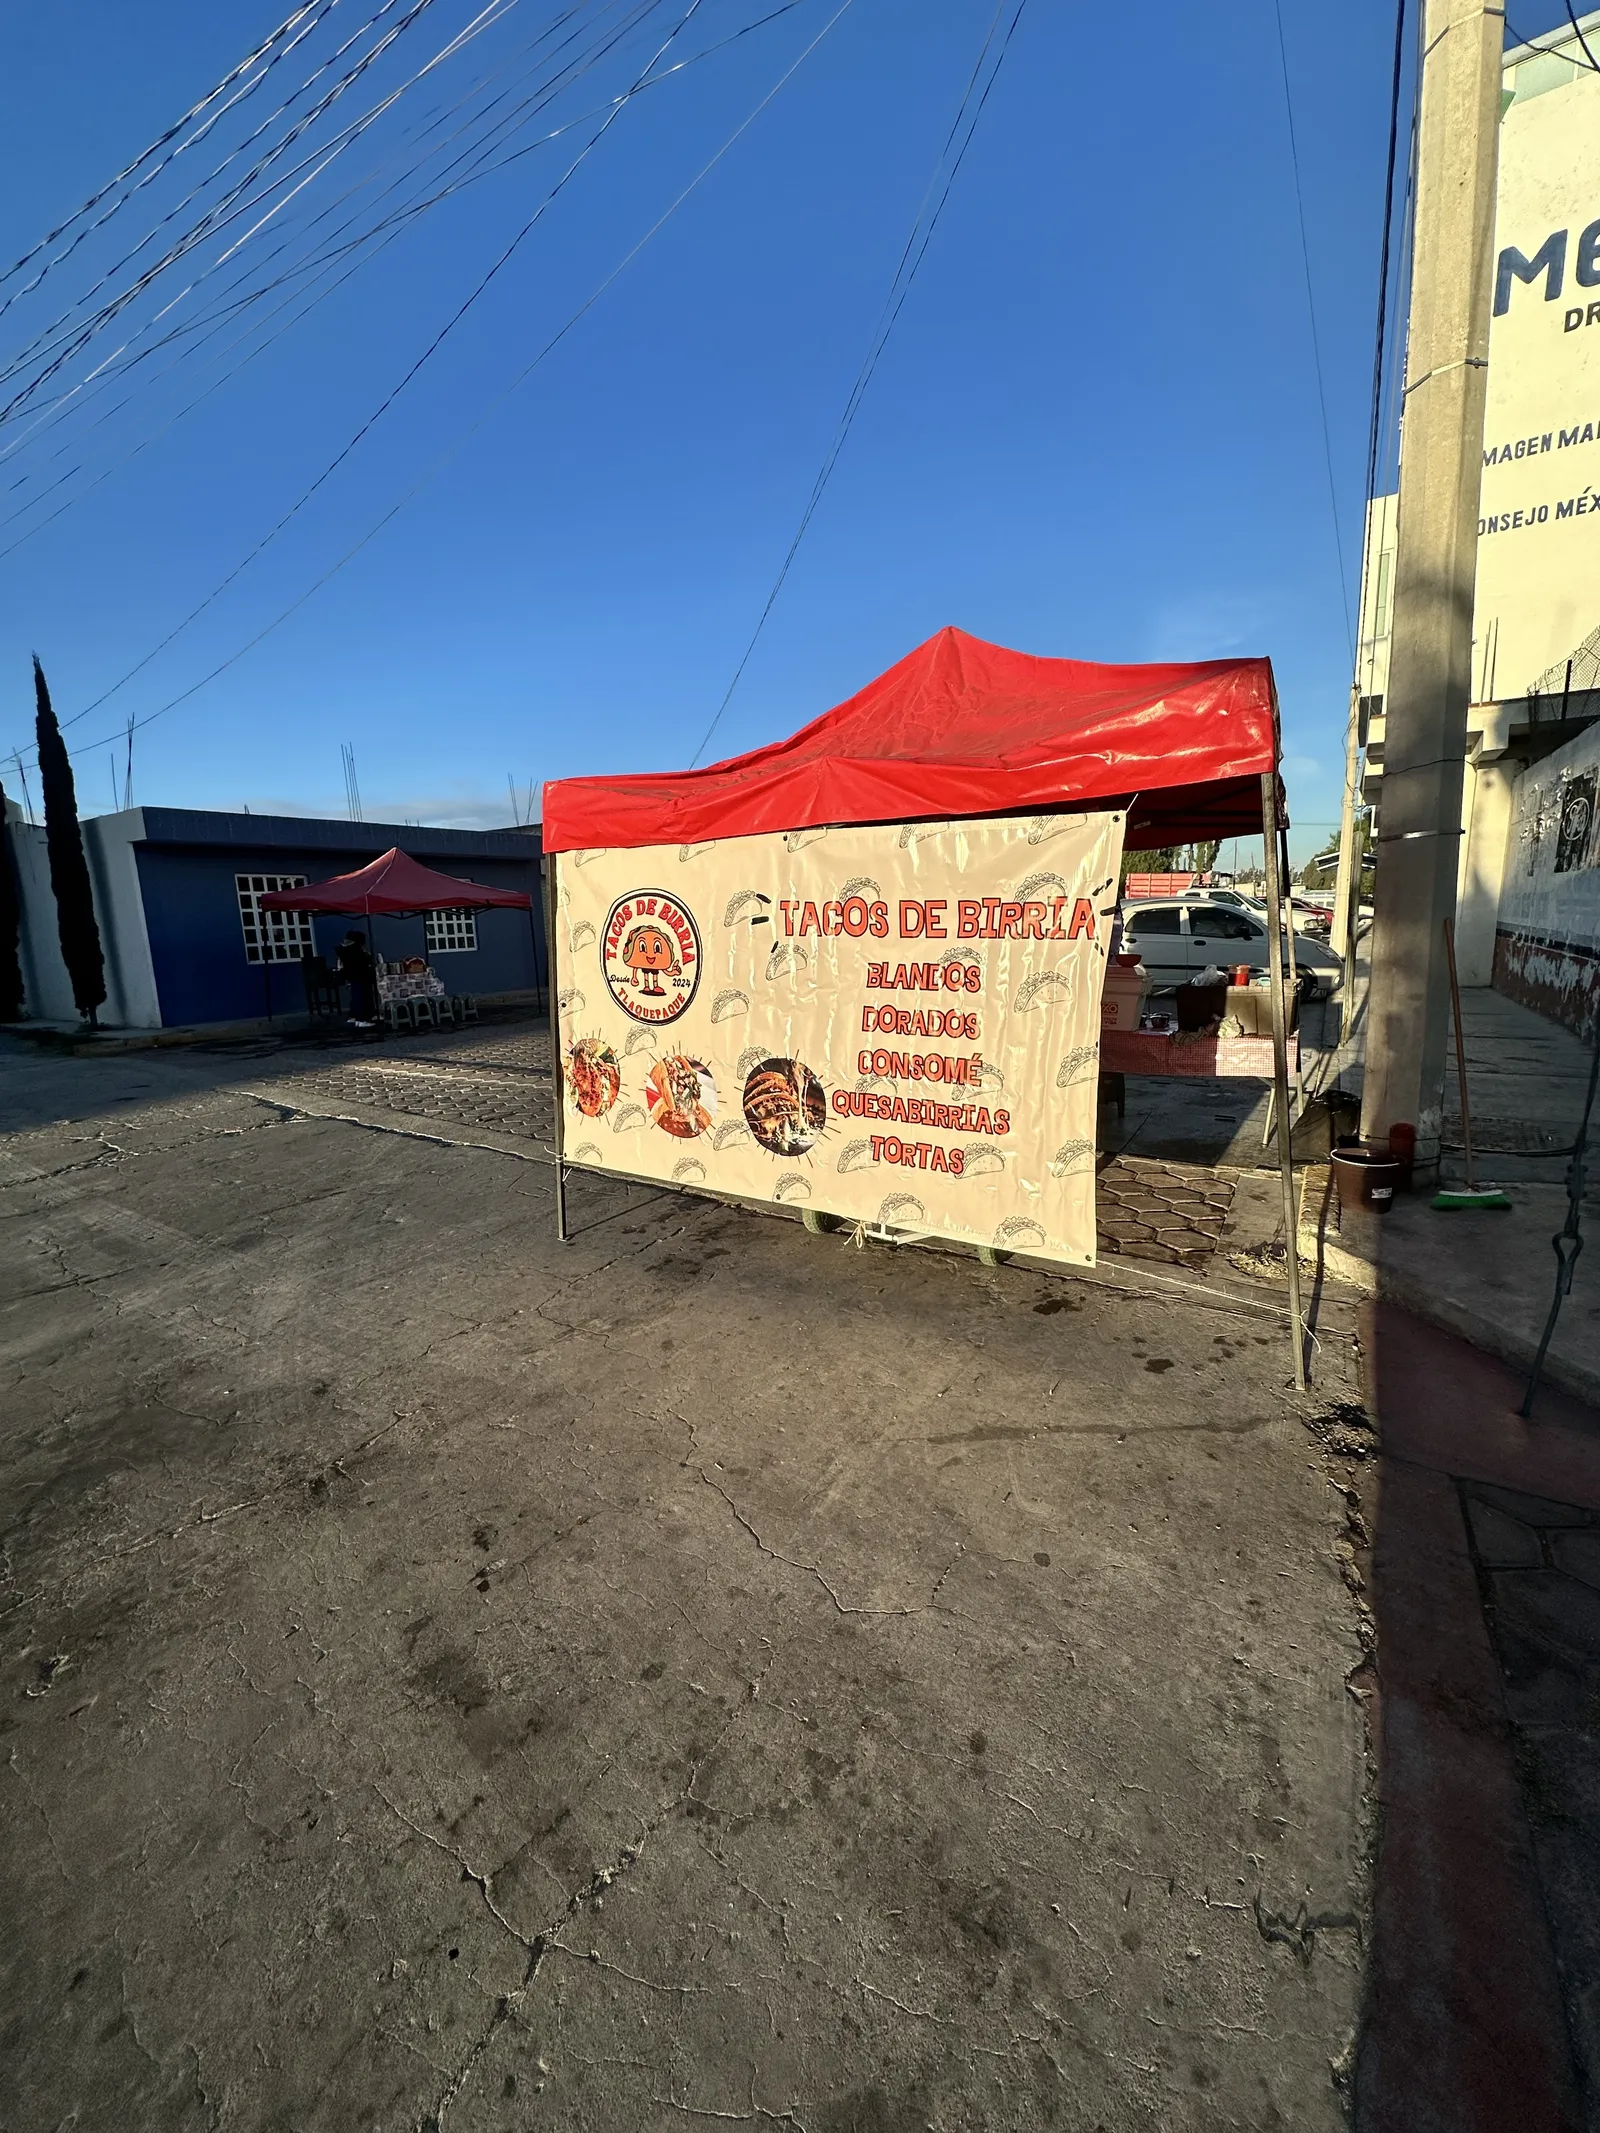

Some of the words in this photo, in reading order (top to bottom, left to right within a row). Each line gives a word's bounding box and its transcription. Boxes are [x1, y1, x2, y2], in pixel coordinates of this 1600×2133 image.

[1482, 431, 1553, 467] MAGEN
[1557, 420, 1600, 449] MA
[1477, 505, 1549, 537] ONSEJO
[605, 904, 633, 961] TACOS
[636, 898, 658, 916] DE
[658, 902, 696, 966] BIRRIA
[779, 895, 890, 939] TACOS
[899, 899, 948, 939] DE
[957, 897, 1097, 940] BIRRIA
[608, 974, 631, 984] Desde
[672, 978, 691, 988] 2024
[866, 961, 982, 993] BLANDOS
[617, 987, 686, 1020] TLAQUEPAQUE
[861, 1004, 982, 1040] DORADOS
[858, 1048, 983, 1087] CONSOMÉ
[832, 1089, 1011, 1135] QUESABIRRIAS
[870, 1135, 965, 1174] TORTAS
